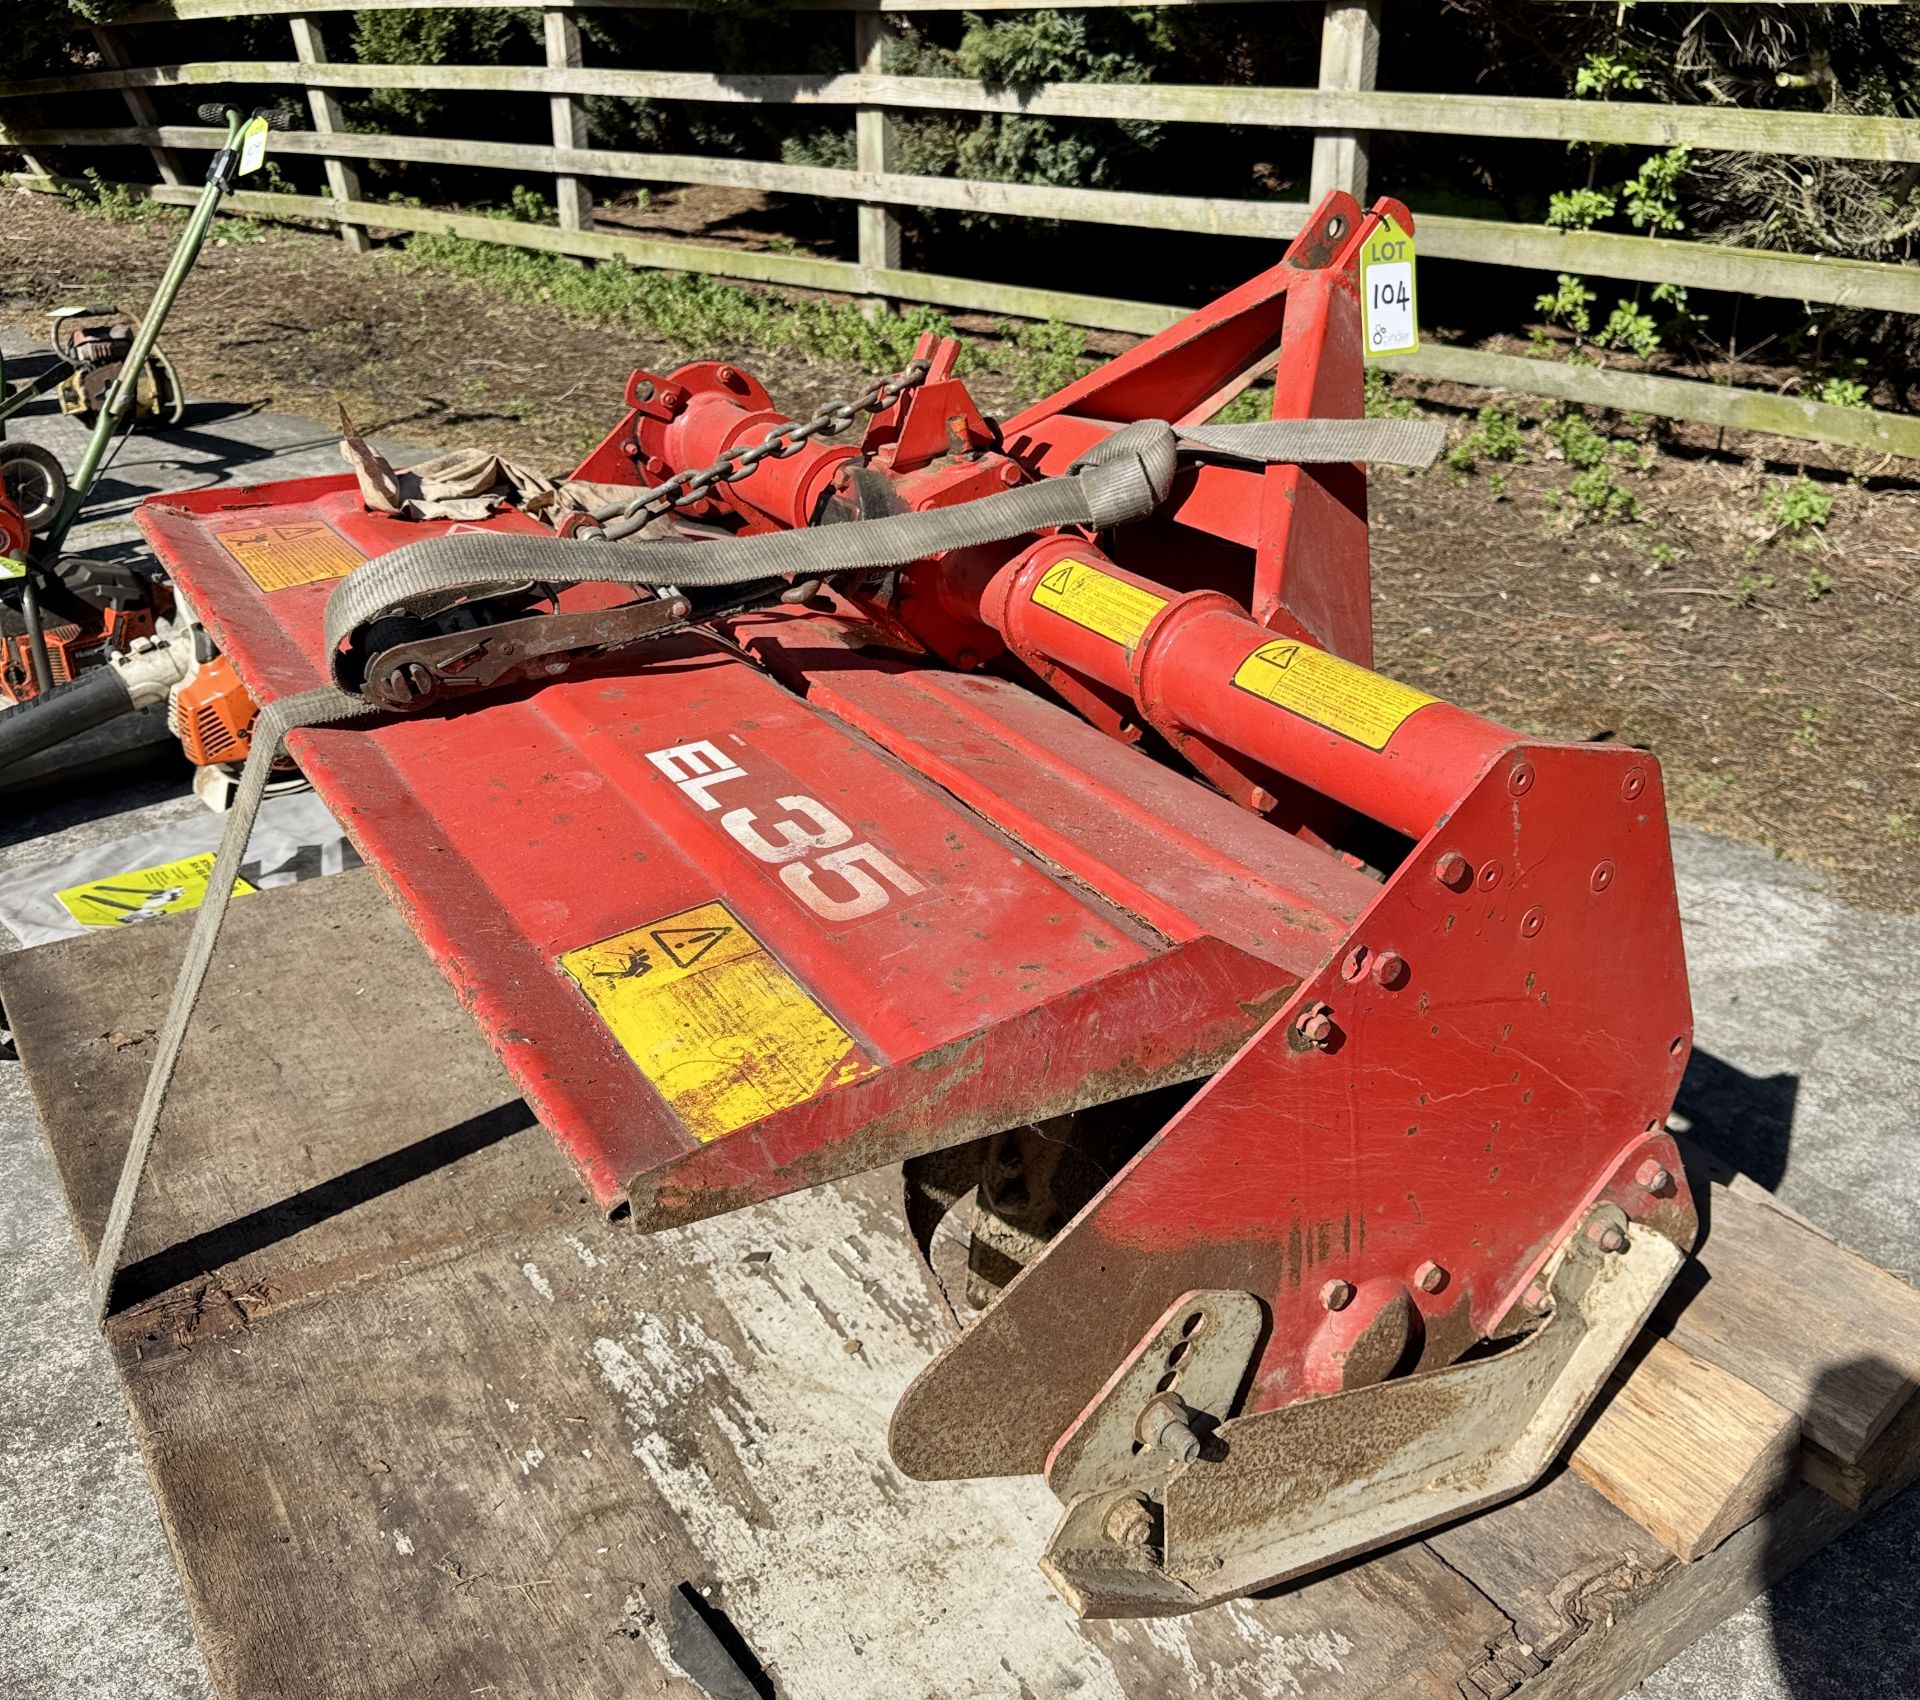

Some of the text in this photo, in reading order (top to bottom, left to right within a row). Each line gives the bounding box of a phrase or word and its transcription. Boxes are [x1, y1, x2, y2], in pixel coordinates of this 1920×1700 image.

[1371, 241, 1406, 262] LOT
[1374, 280, 1410, 312] 104
[644, 739, 927, 921] EL 35
